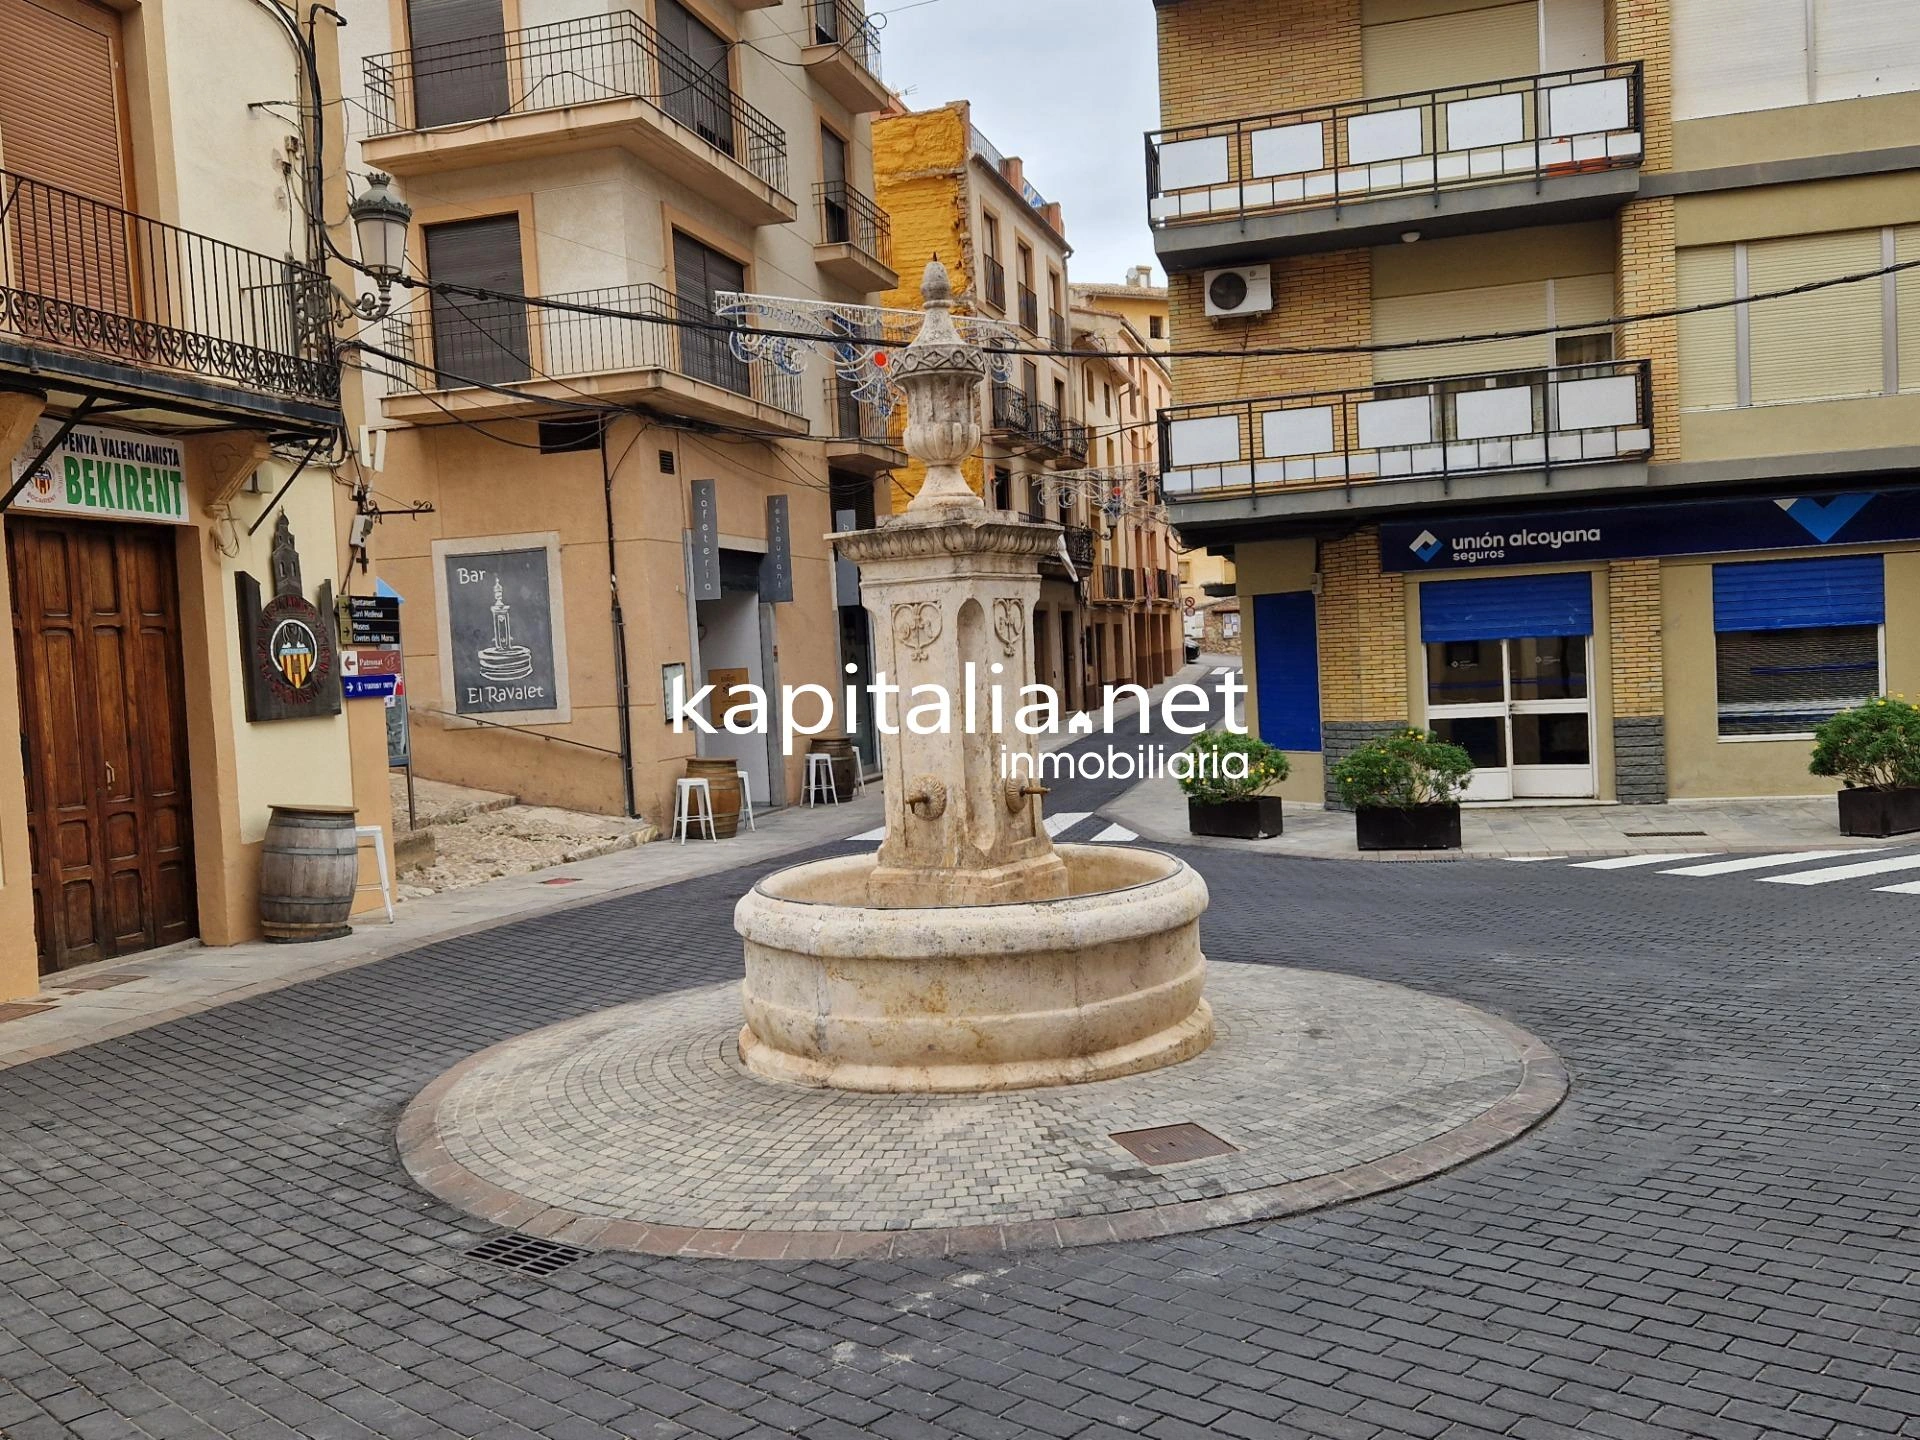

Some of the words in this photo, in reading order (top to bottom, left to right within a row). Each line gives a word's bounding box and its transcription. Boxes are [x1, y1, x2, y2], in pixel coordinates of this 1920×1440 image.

[62, 432, 99, 456] PENYA
[100, 437, 180, 468] VALENCIANISTA
[64, 456, 182, 516] BEKIRENT
[700, 487, 711, 591] cafeteria
[774, 498, 783, 589] restaurant
[1452, 531, 1504, 550] unión
[1509, 528, 1601, 549] alcoyana
[1452, 550, 1505, 563] seguros
[457, 567, 486, 585] Bar
[468, 688, 483, 703] El
